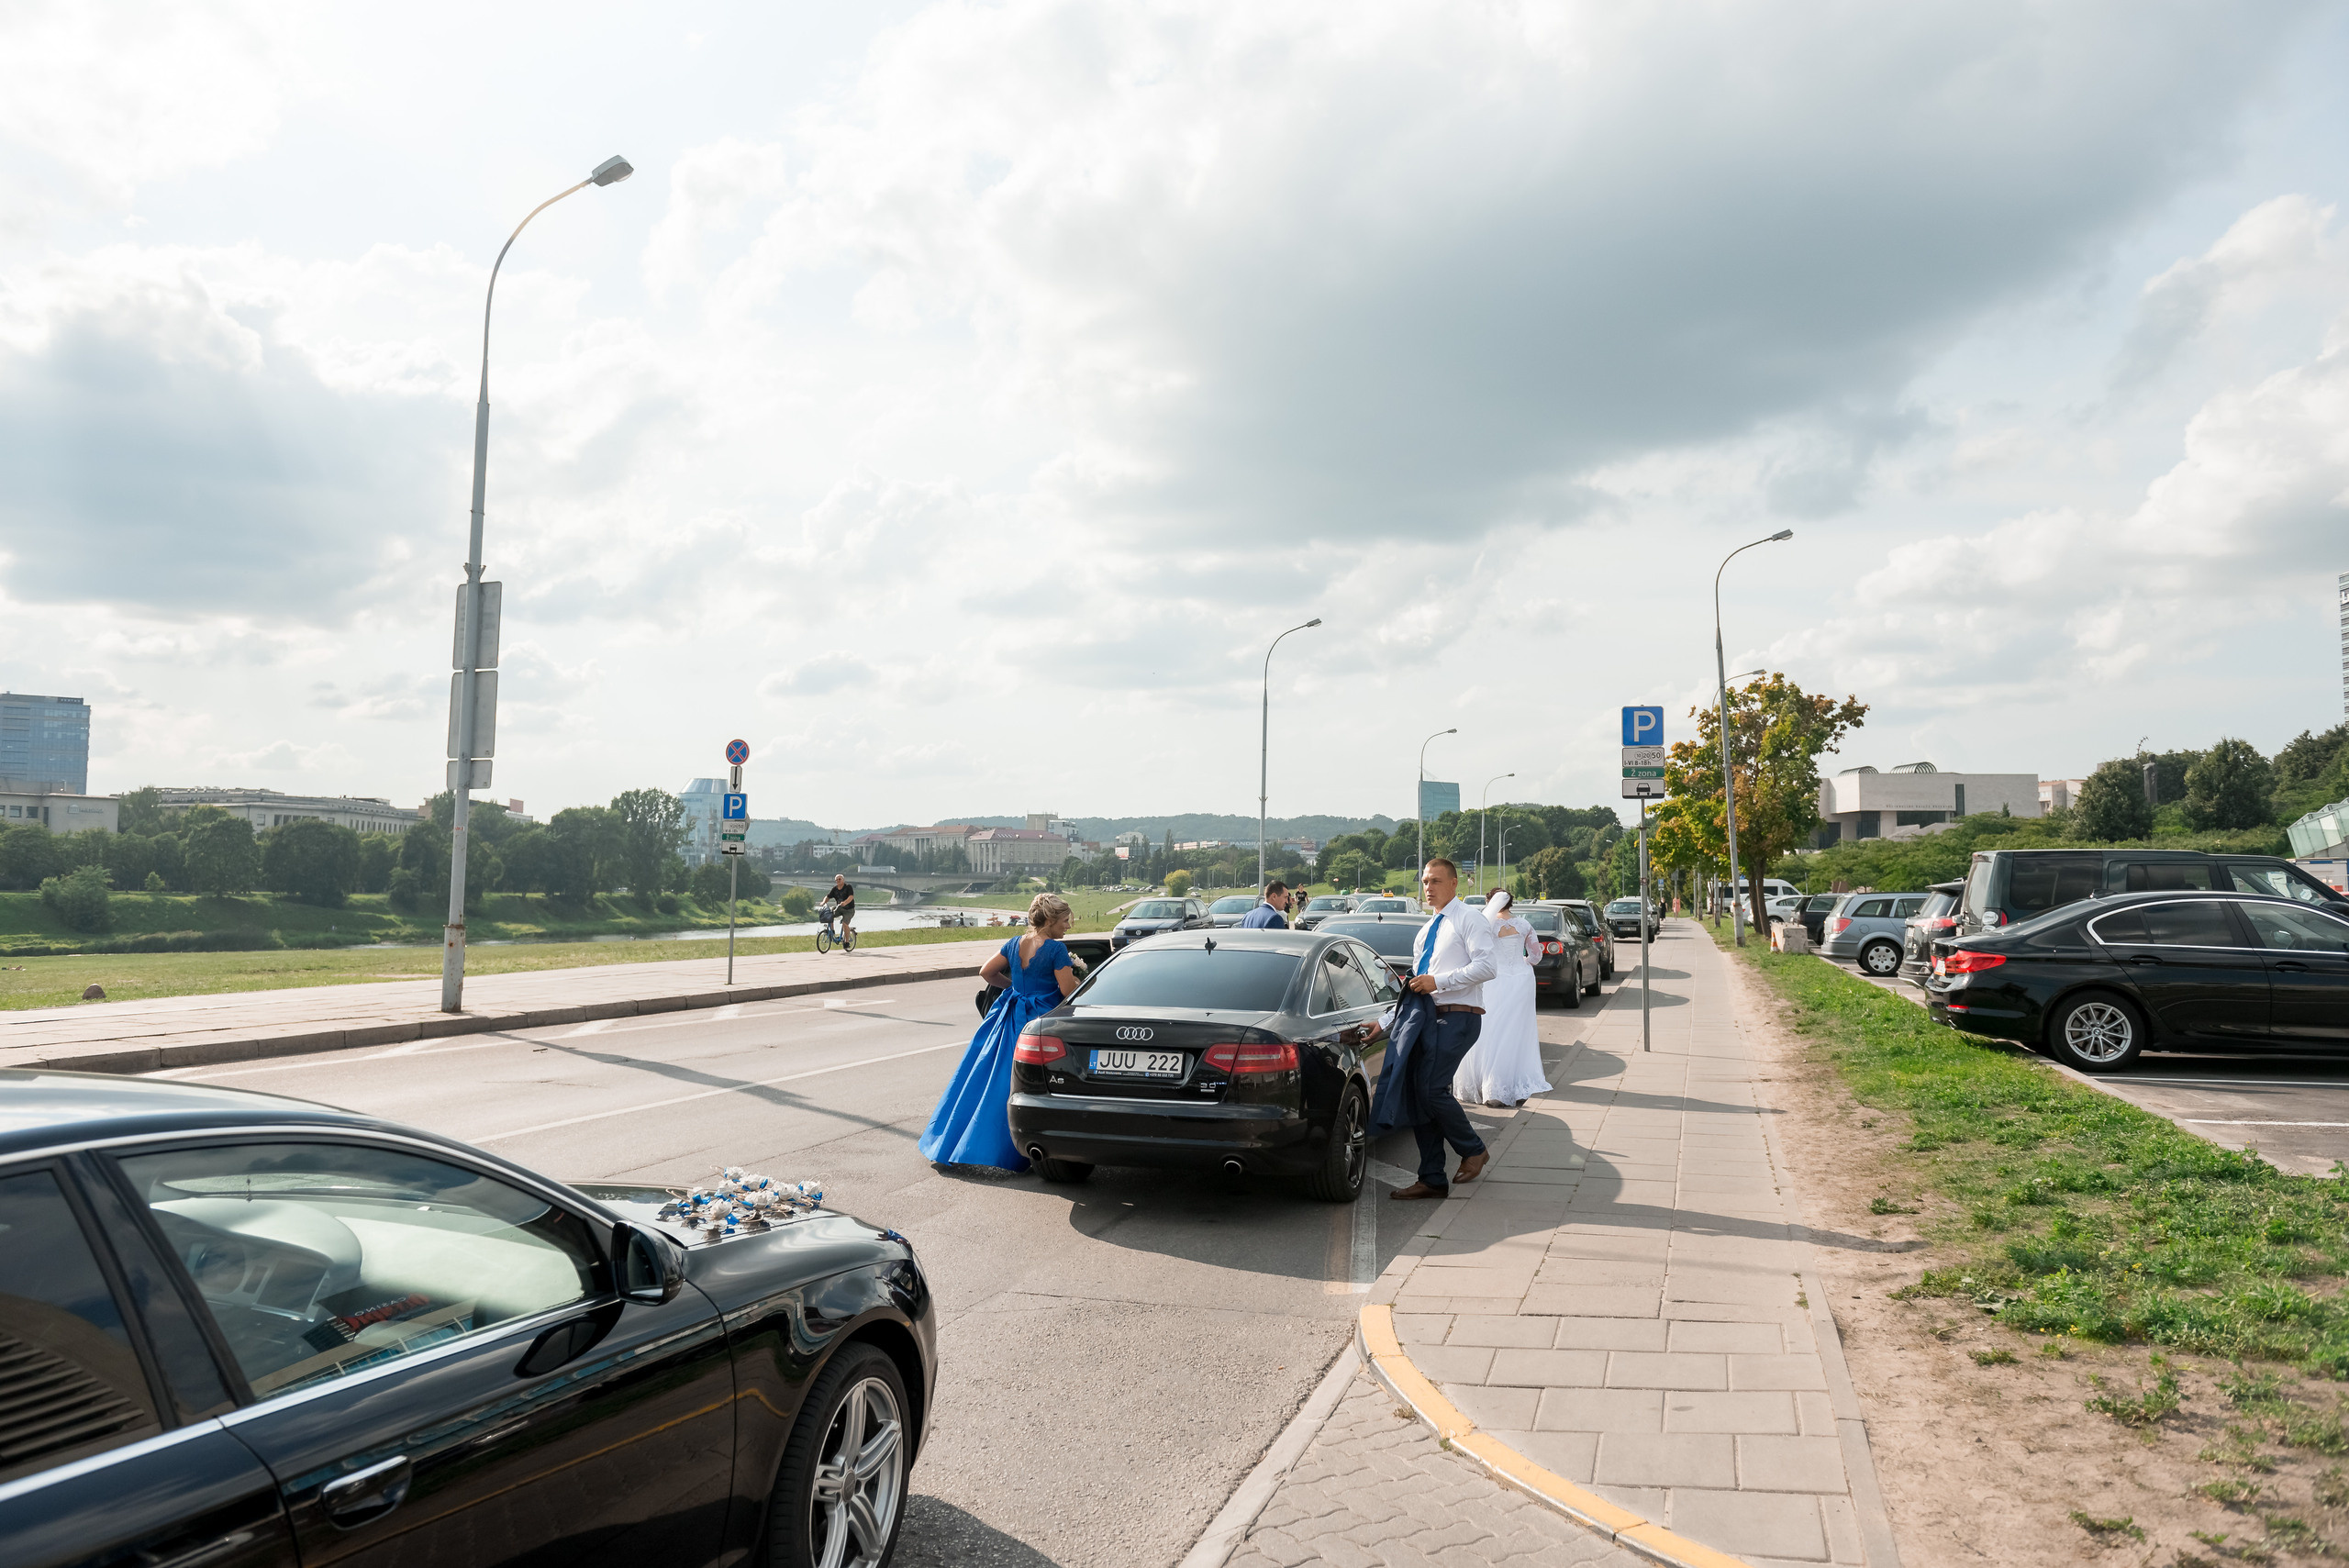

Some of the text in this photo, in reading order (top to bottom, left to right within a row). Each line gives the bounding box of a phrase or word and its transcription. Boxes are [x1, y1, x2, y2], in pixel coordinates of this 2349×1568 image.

[1634, 710, 1655, 741] P
[729, 796, 742, 817] P
[1100, 1052, 1179, 1072] JUU 222
[1050, 1075, 1063, 1084] A6
